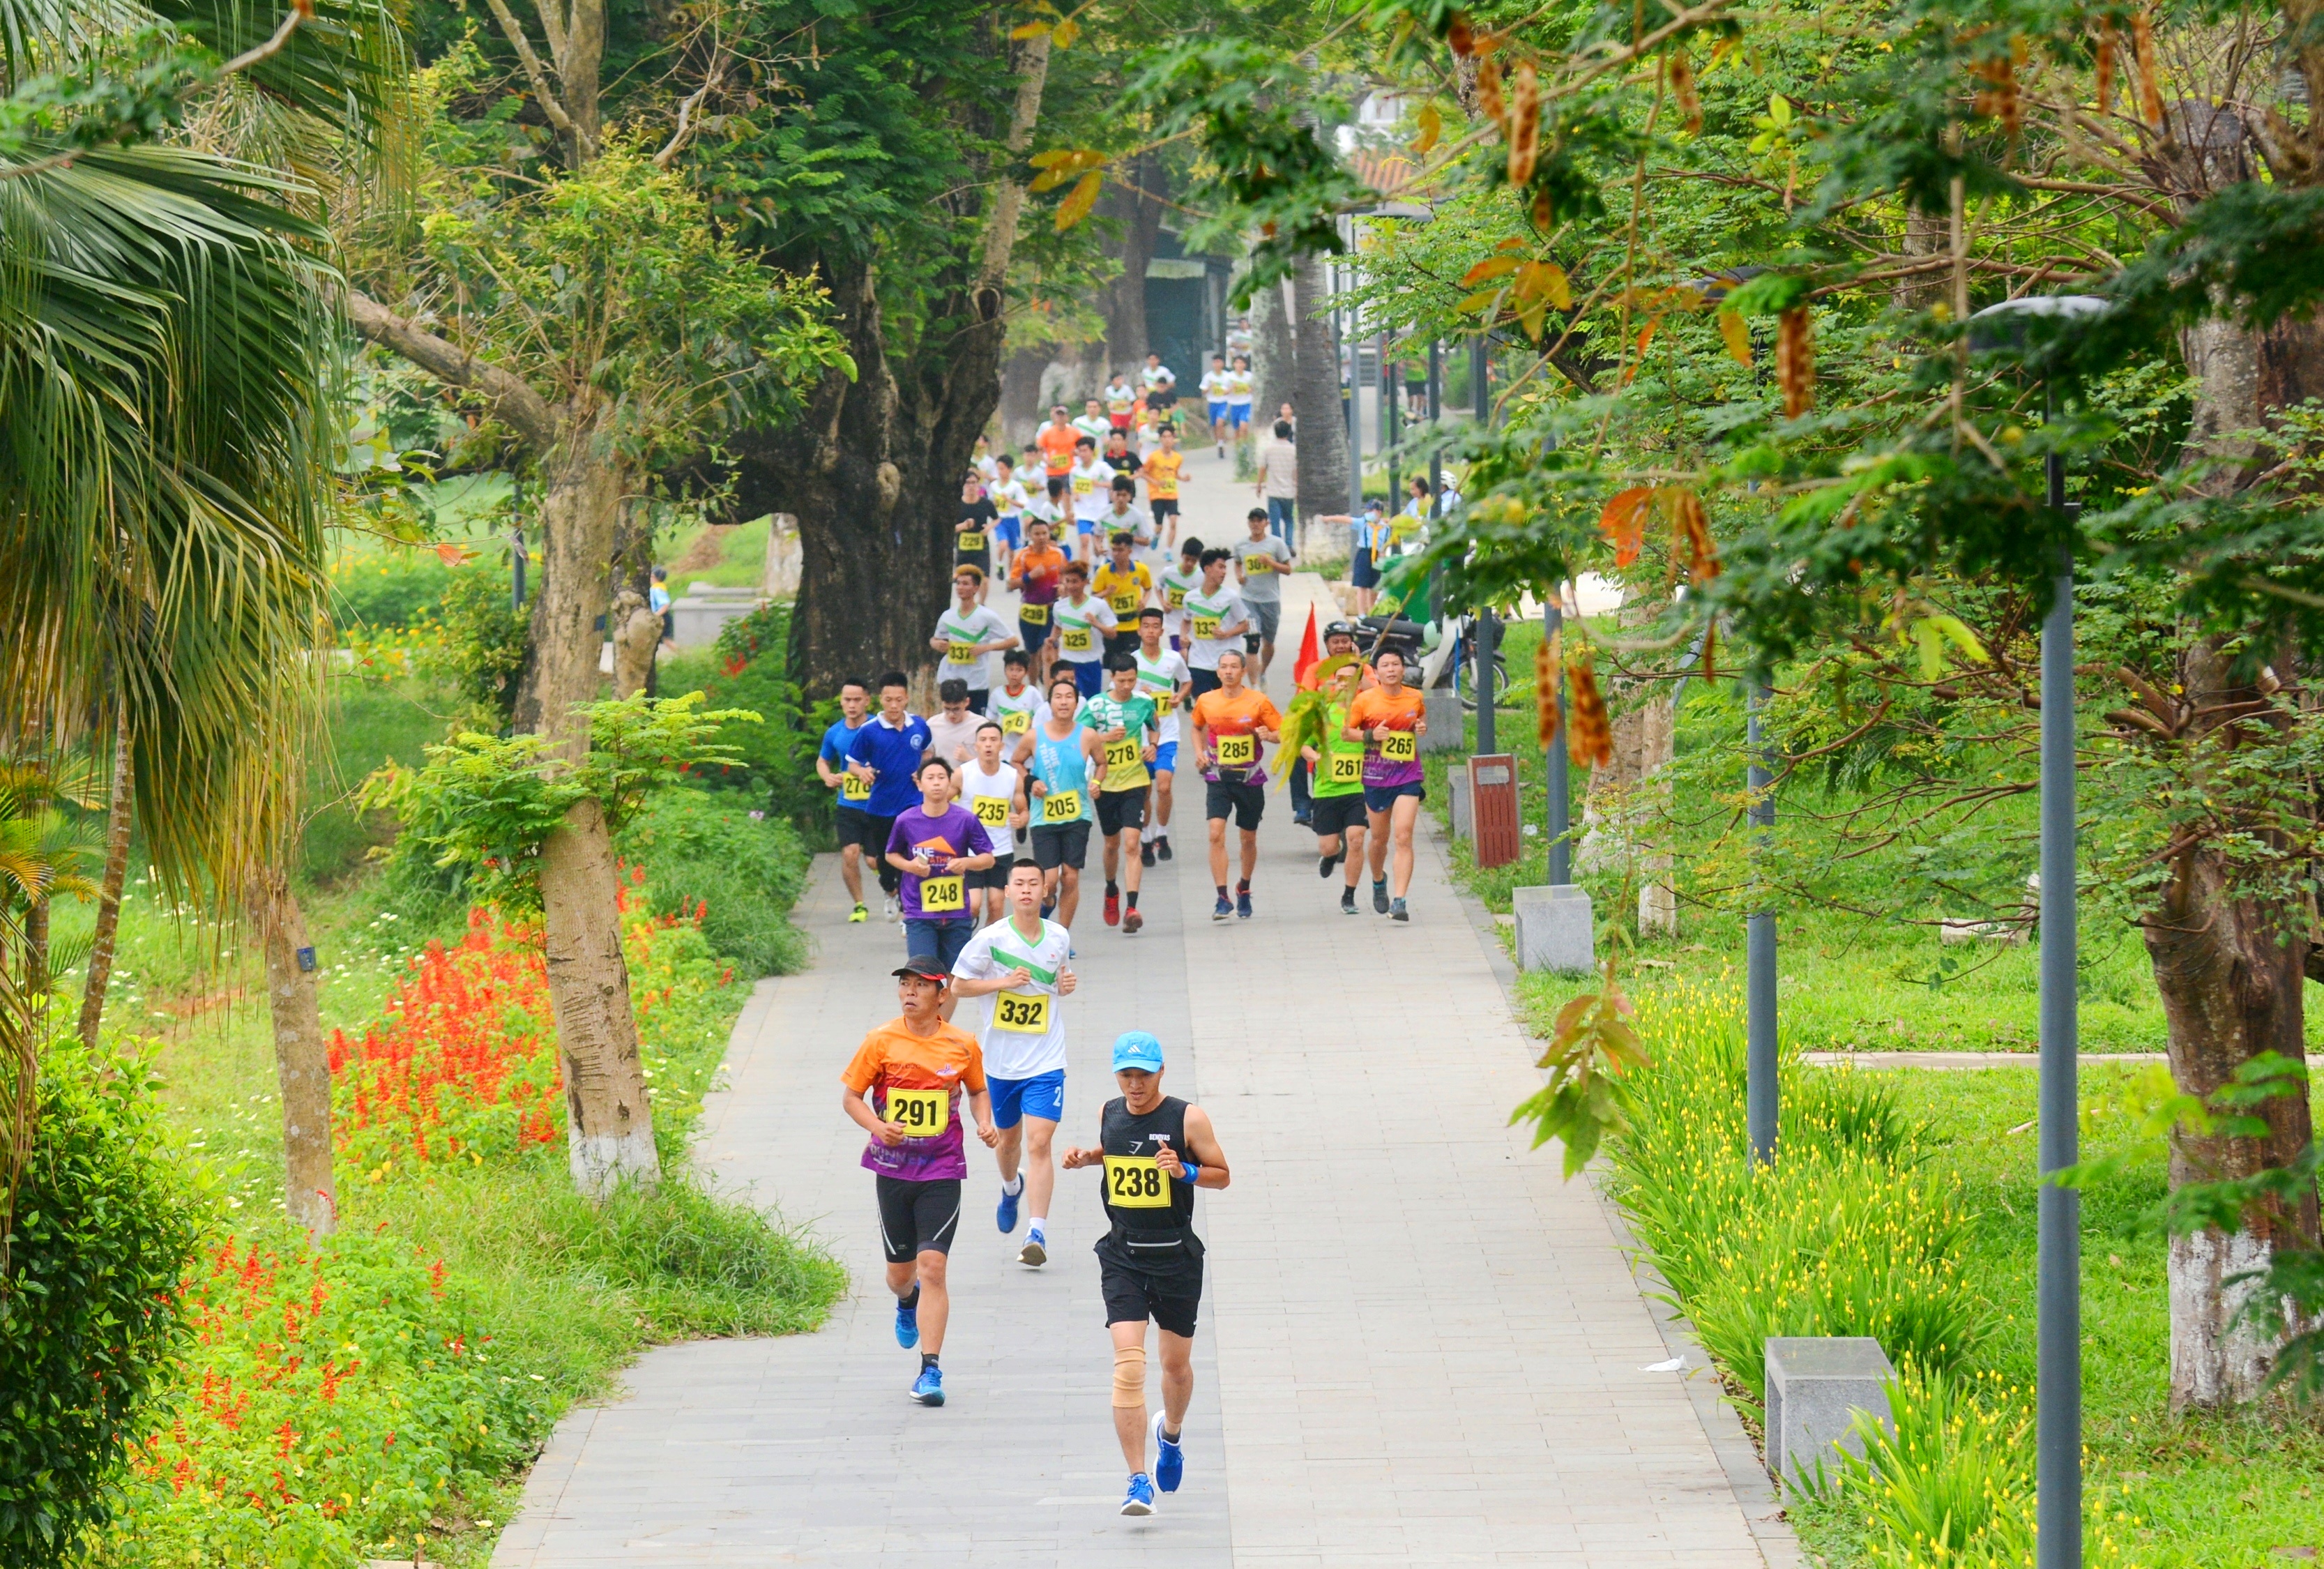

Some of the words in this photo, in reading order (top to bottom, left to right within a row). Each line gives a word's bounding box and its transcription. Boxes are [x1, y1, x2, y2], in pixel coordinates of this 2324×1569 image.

[1154, 697, 1169, 711] 17
[1107, 745, 1134, 765] 278
[1222, 741, 1249, 758] 285
[1385, 736, 1413, 755] 265
[1335, 759, 1360, 776] 261
[978, 802, 1005, 821] 235
[1047, 797, 1075, 817] 205
[927, 883, 957, 904] 248
[1000, 999, 1042, 1025] 332
[1052, 1086, 1061, 1107] 2
[894, 1098, 937, 1127] 291
[1113, 1167, 1161, 1197] 238
